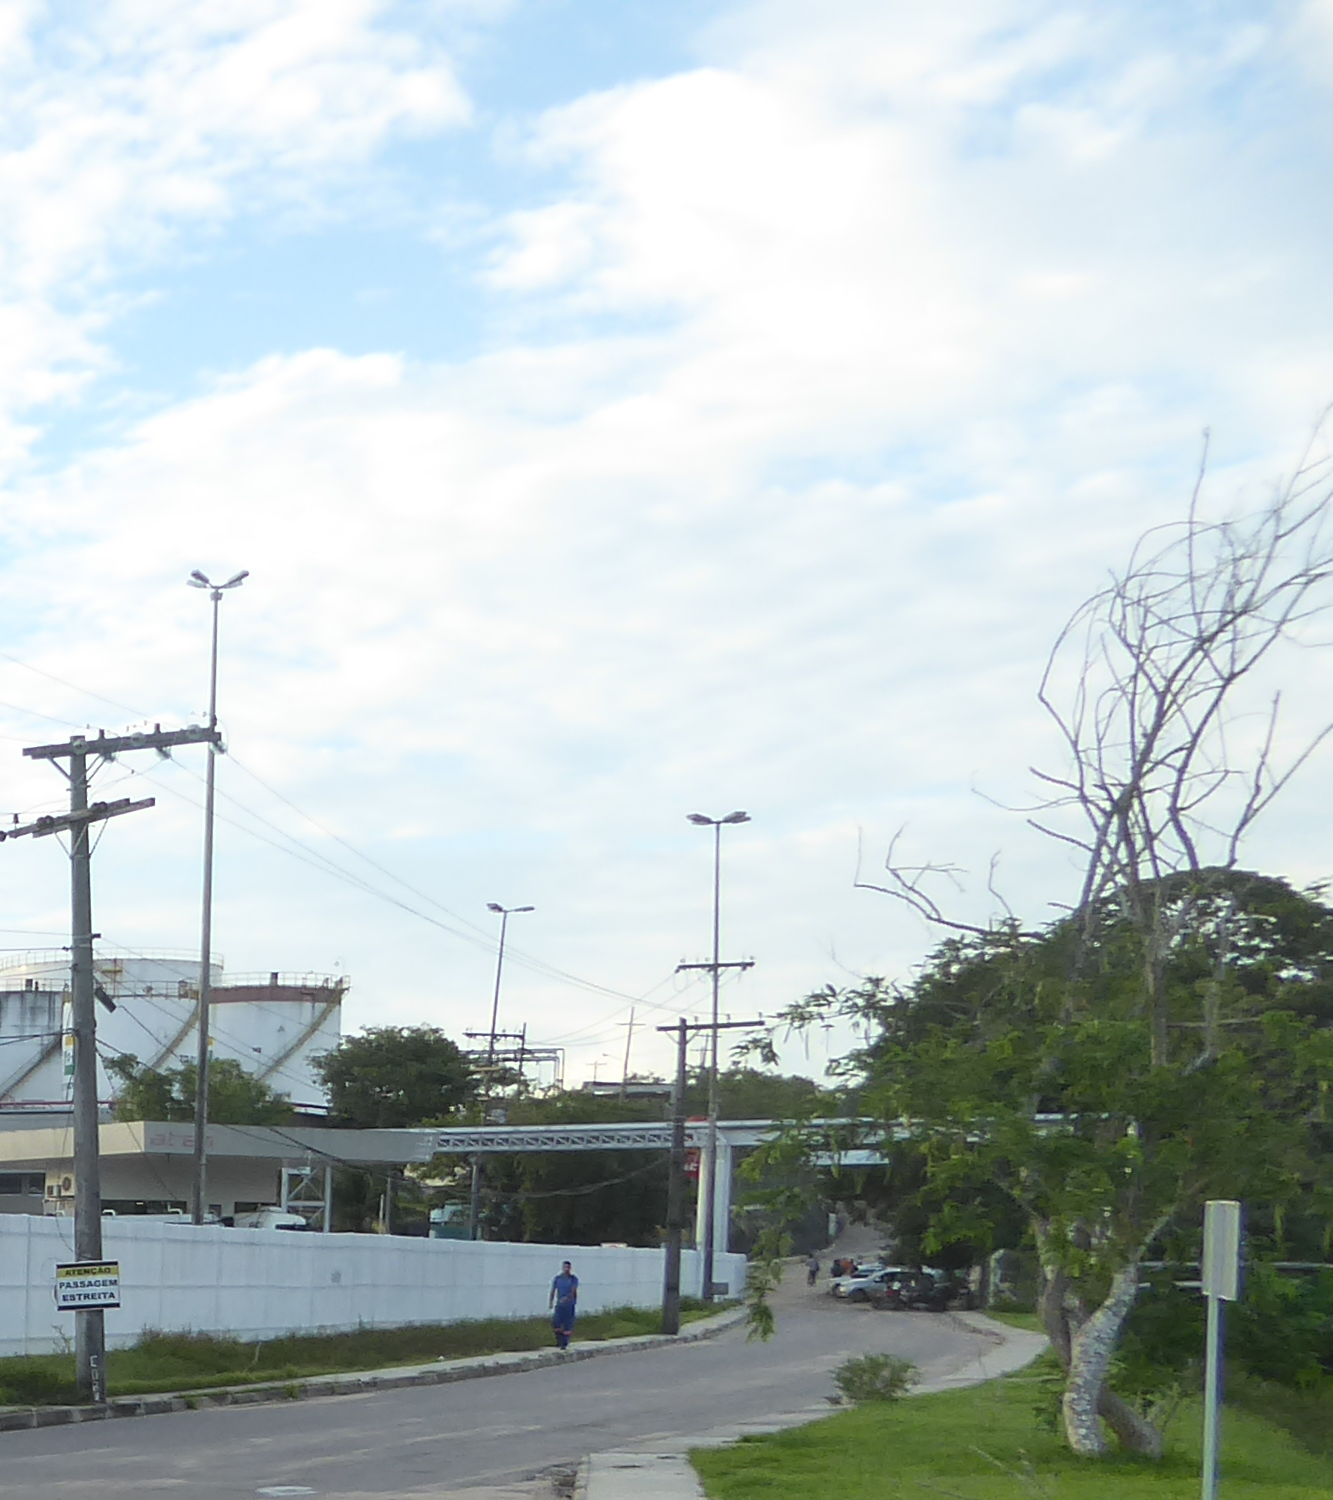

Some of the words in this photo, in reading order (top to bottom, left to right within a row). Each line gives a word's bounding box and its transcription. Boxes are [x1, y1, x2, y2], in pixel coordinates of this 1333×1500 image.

[64, 1266, 112, 1277] ATENÇÃO
[59, 1279, 118, 1290] PASSAGEM
[62, 1291, 116, 1302] ESTREITA
